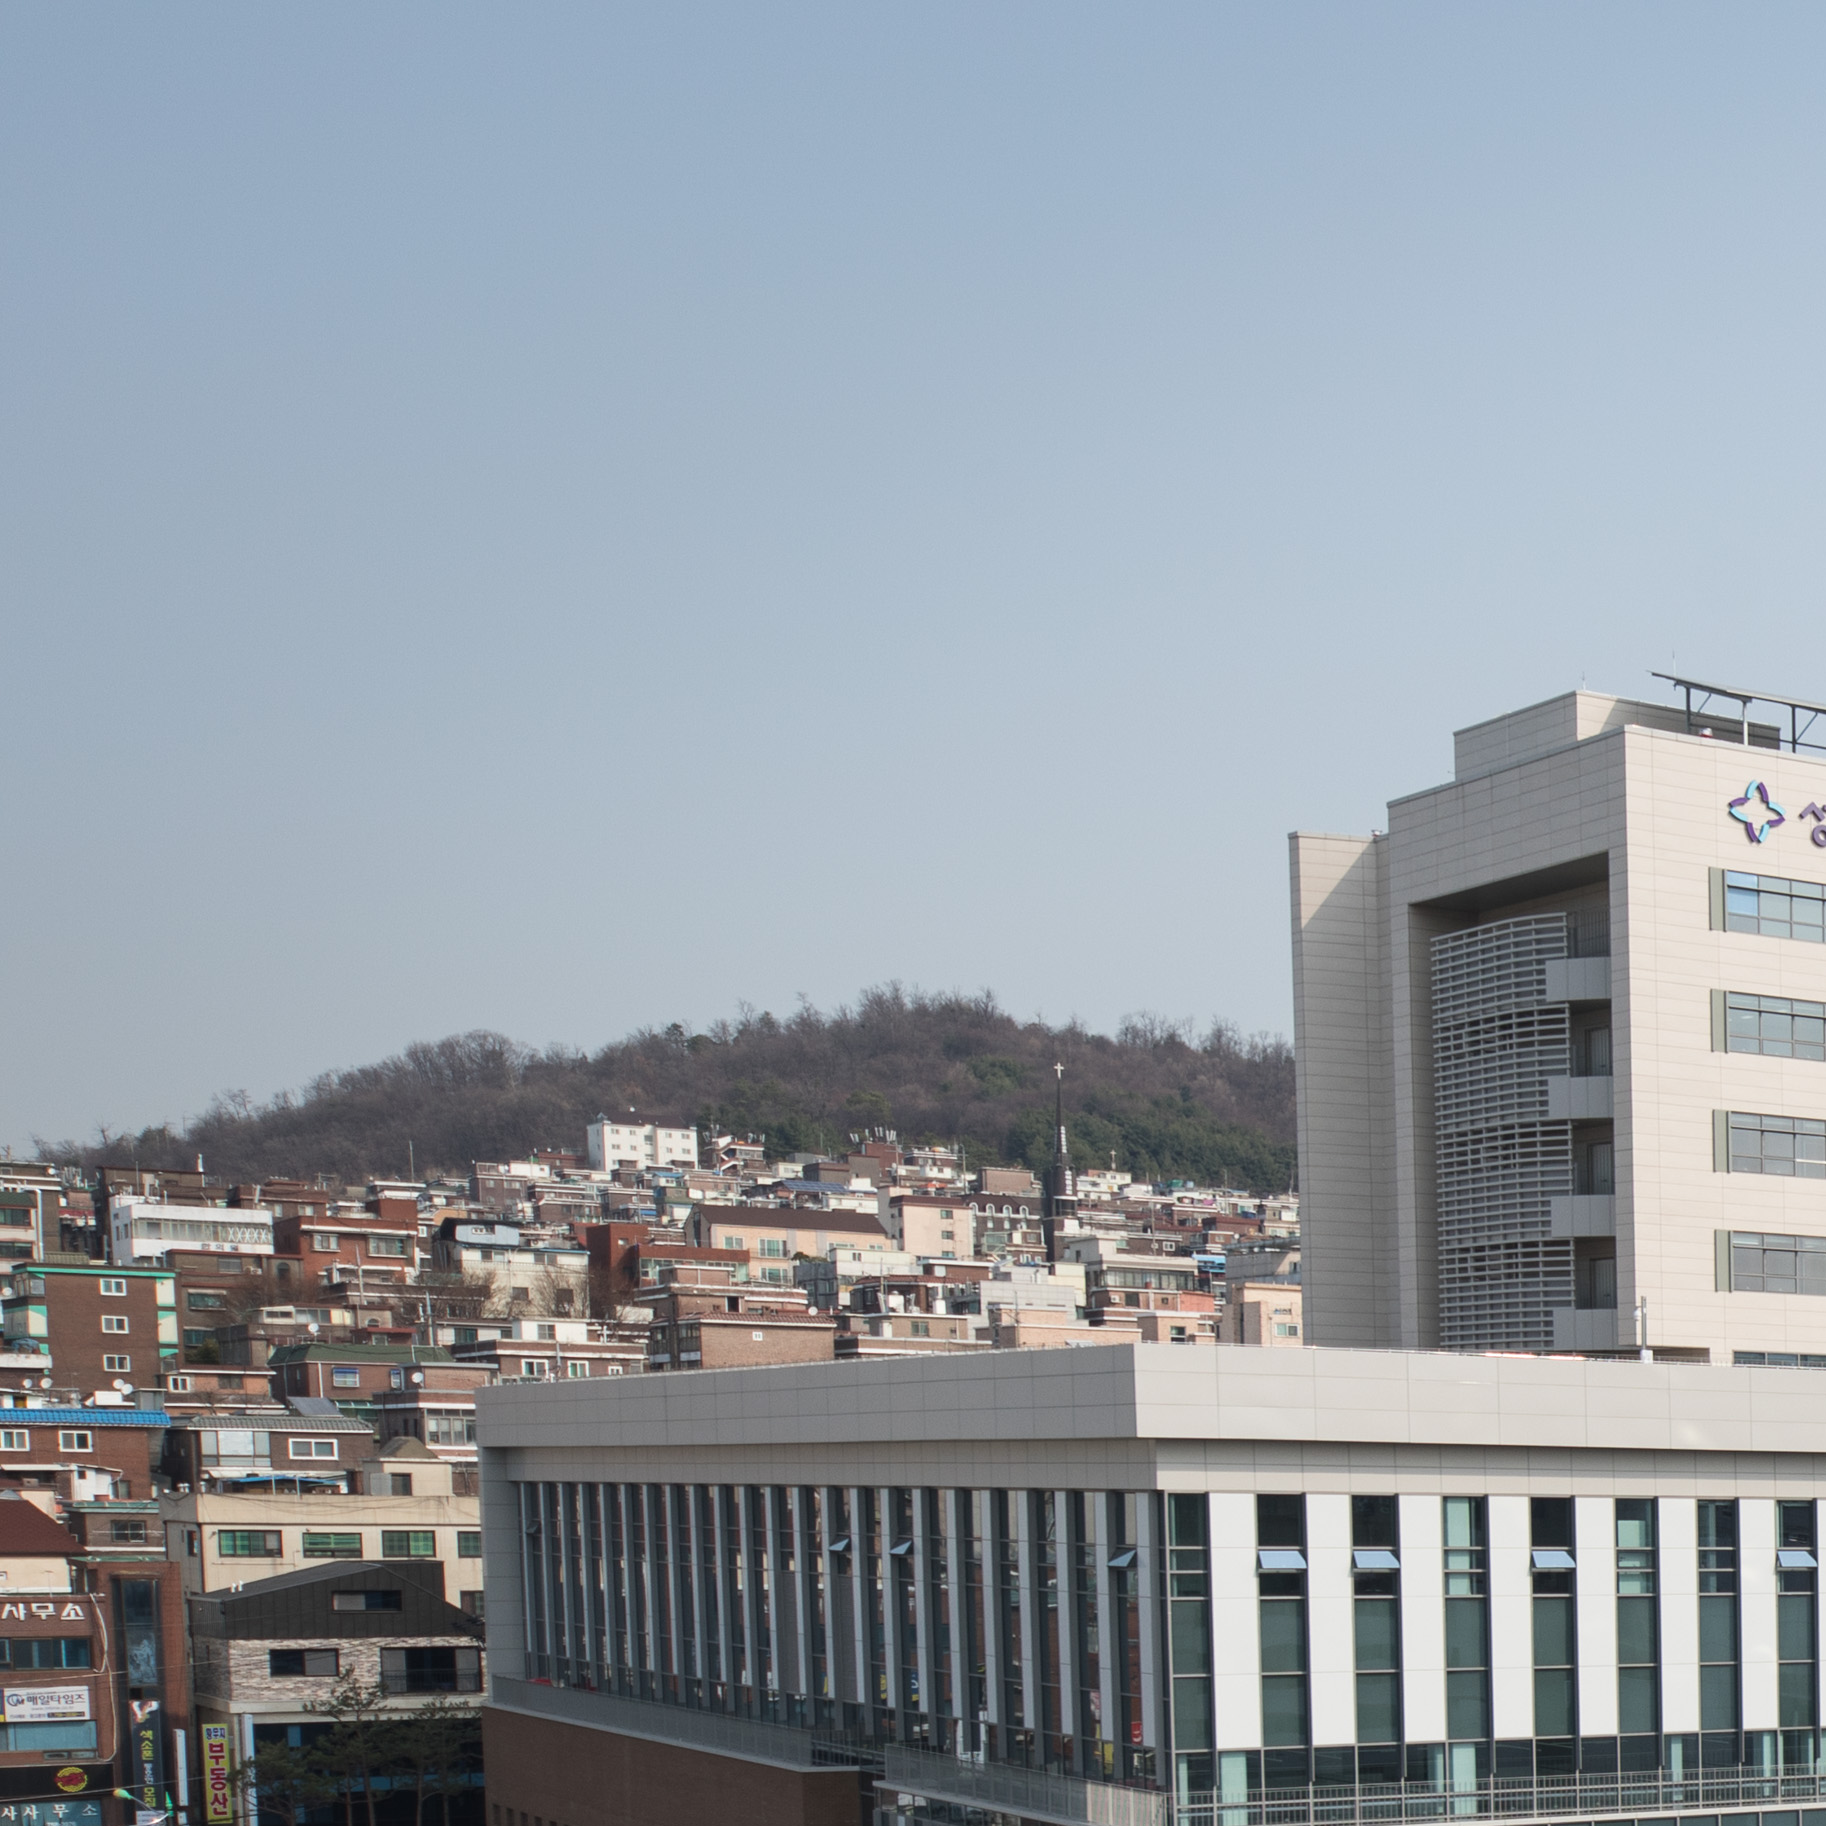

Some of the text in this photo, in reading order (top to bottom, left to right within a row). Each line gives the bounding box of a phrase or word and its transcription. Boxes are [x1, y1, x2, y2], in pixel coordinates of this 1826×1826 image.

[1, 1603, 85, 1621] 사무소
[26, 1693, 86, 1706] 매일타임즈
[208, 1742, 229, 1816] 부동산
